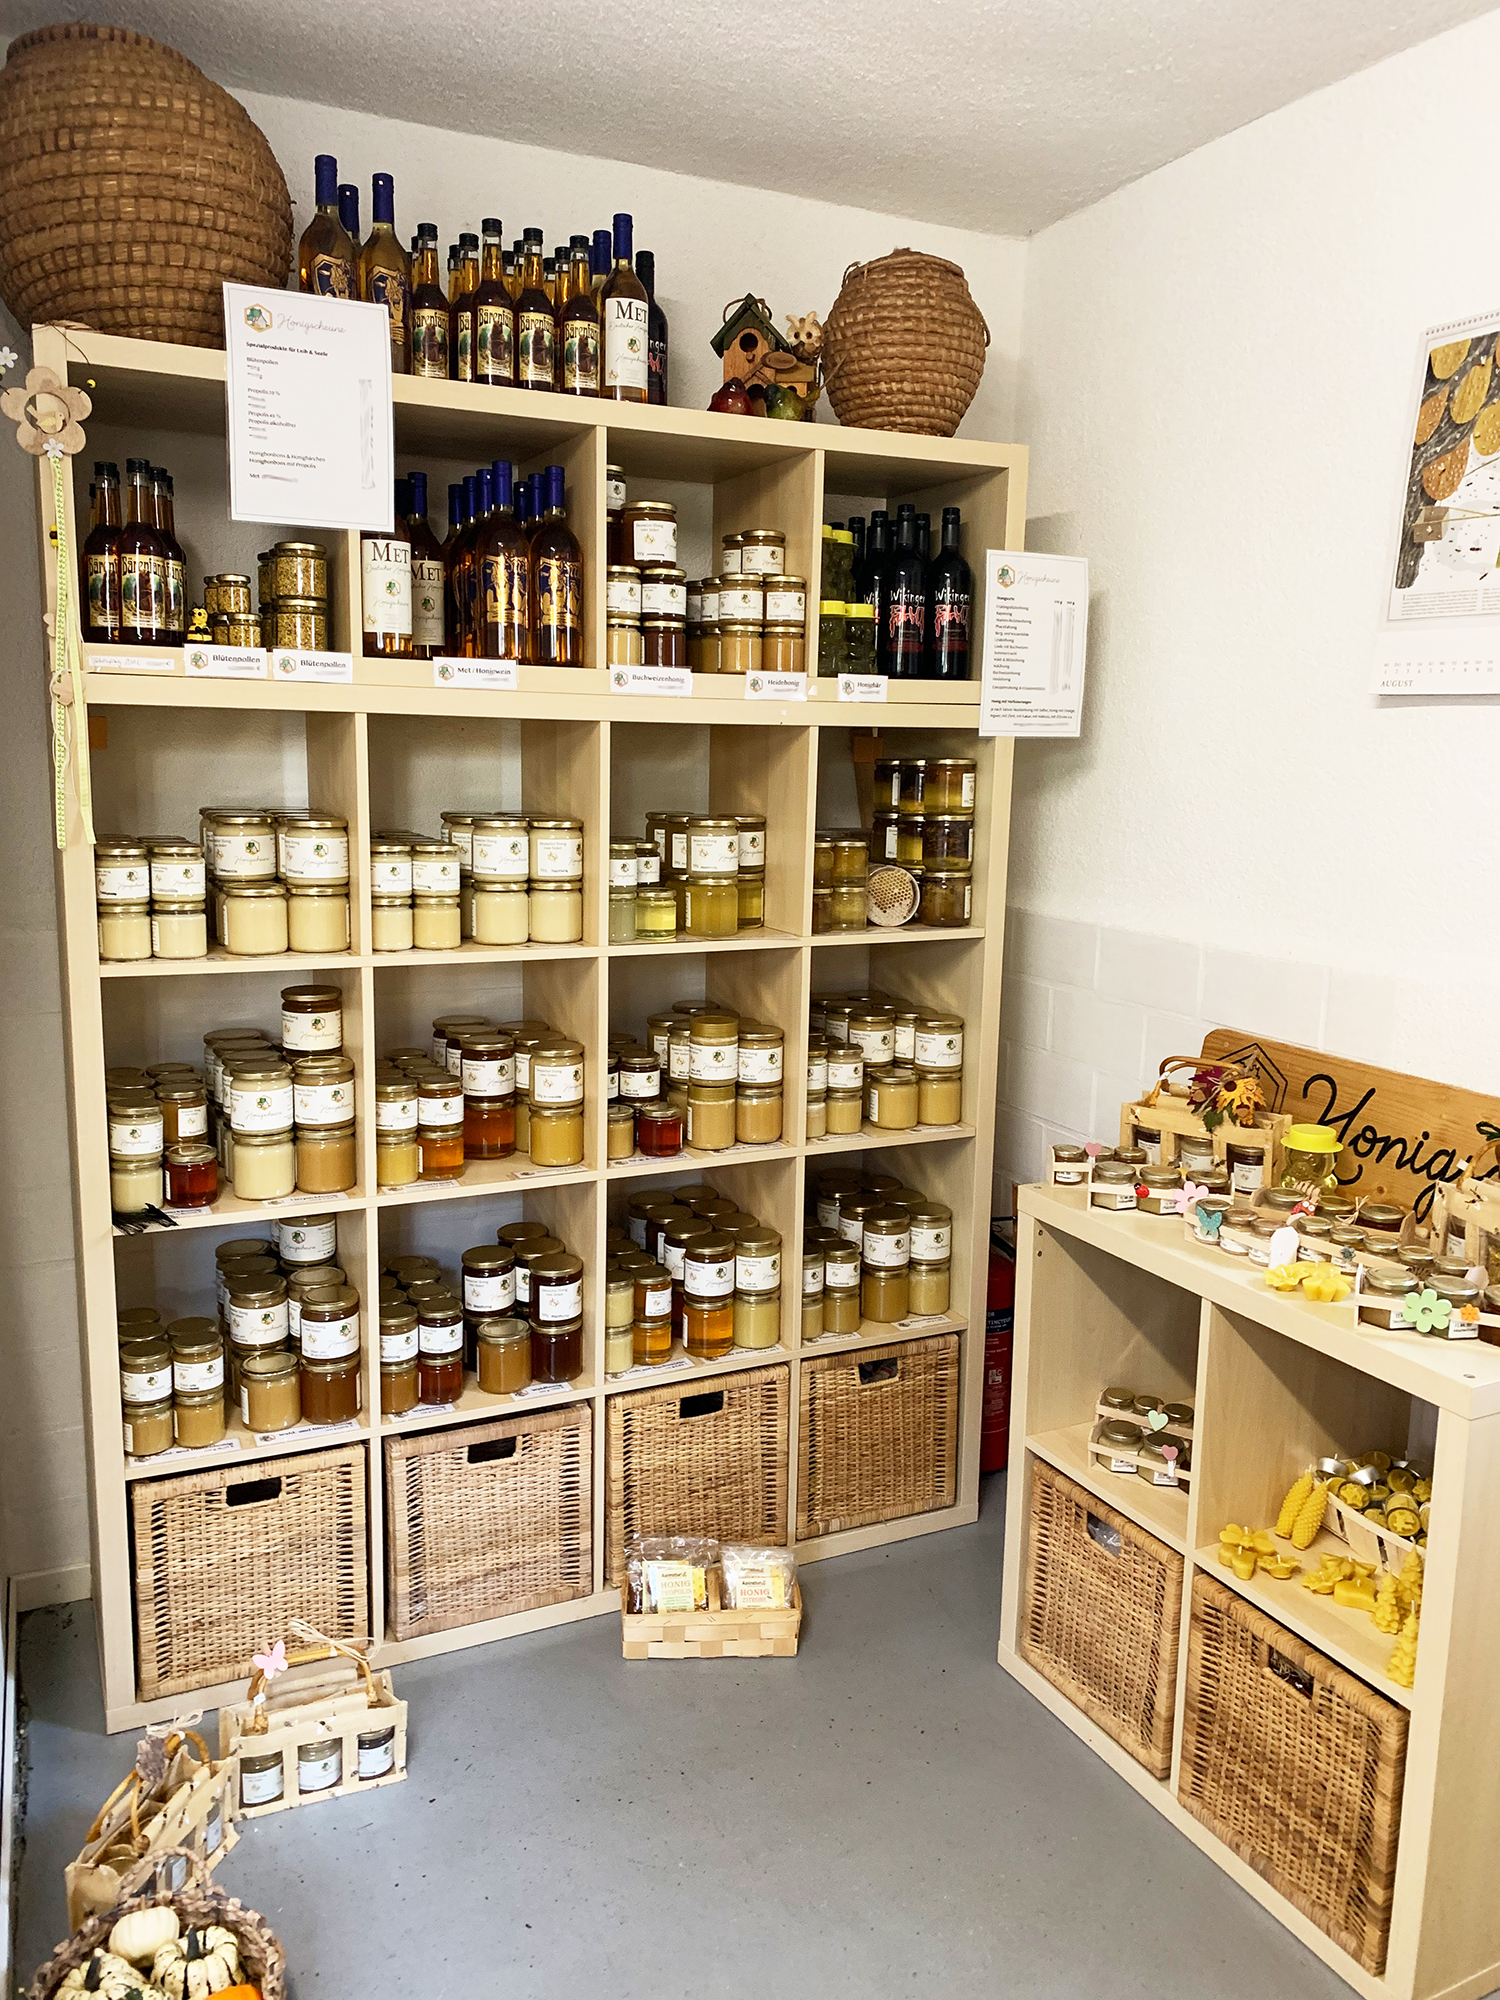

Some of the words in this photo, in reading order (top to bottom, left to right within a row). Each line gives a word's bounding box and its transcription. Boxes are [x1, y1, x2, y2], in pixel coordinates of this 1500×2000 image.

[615, 300, 648, 324] MET
[246, 341, 288, 352] Spezialprodukte
[246, 356, 279, 366] Blütenpollen
[247, 387, 269, 395] Propolis
[248, 410, 269, 418] Propolis
[248, 418, 269, 426] Propolis
[372, 541, 409, 564] MET
[890, 587, 925, 607] Wikinger
[212, 654, 261, 664] Blütenpollen
[300, 659, 347, 668] Blütenpollen
[475, 668, 511, 676] Honigwein
[632, 673, 685, 684] Buchweizenhonig
[767, 679, 800, 687] Heidehonig
[857, 681, 882, 689] Honigbär
[661, 1580, 691, 1589] HONIG
[740, 1588, 770, 1597] HONIG
